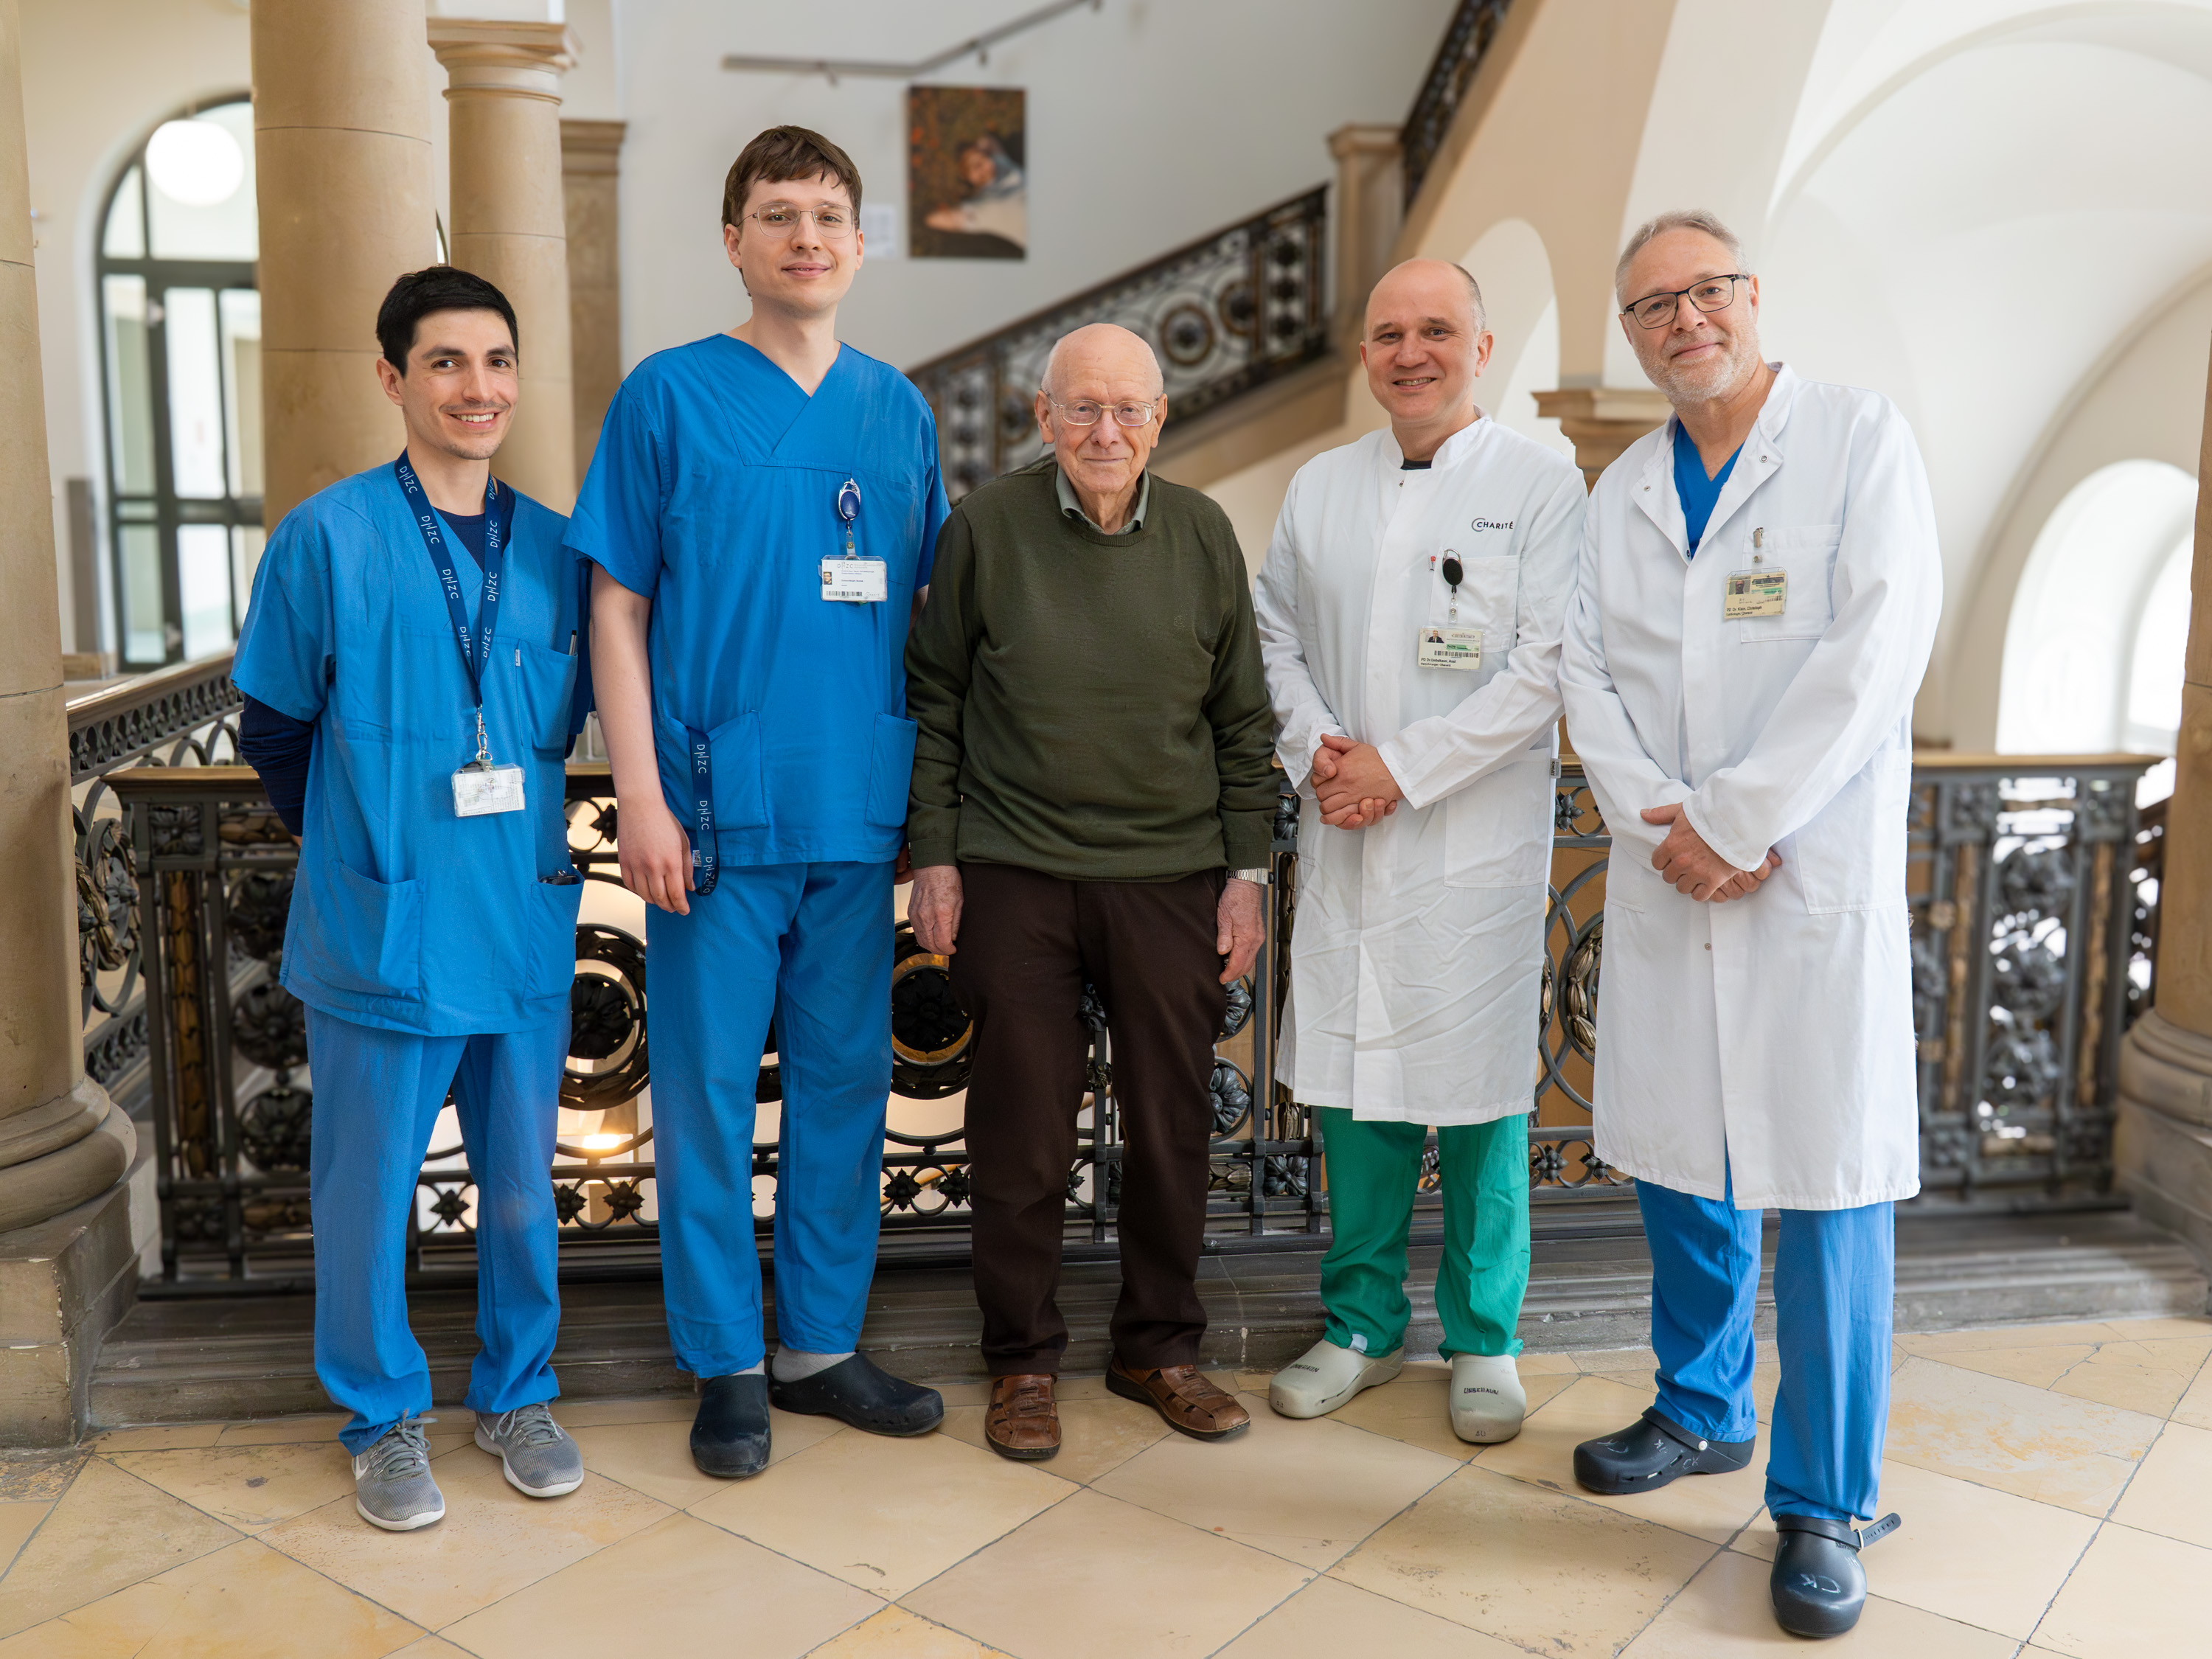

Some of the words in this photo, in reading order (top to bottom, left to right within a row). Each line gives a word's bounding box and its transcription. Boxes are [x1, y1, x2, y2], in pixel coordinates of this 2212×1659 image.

[421, 515, 440, 545] DHZC
[486, 520, 501, 548] DHZC
[1471, 517, 1514, 532] CHARITÉ
[442, 568, 459, 599] DHZC
[484, 571, 499, 602] DHZC
[694, 744, 710, 774] DHZC
[697, 800, 712, 831] DHZC
